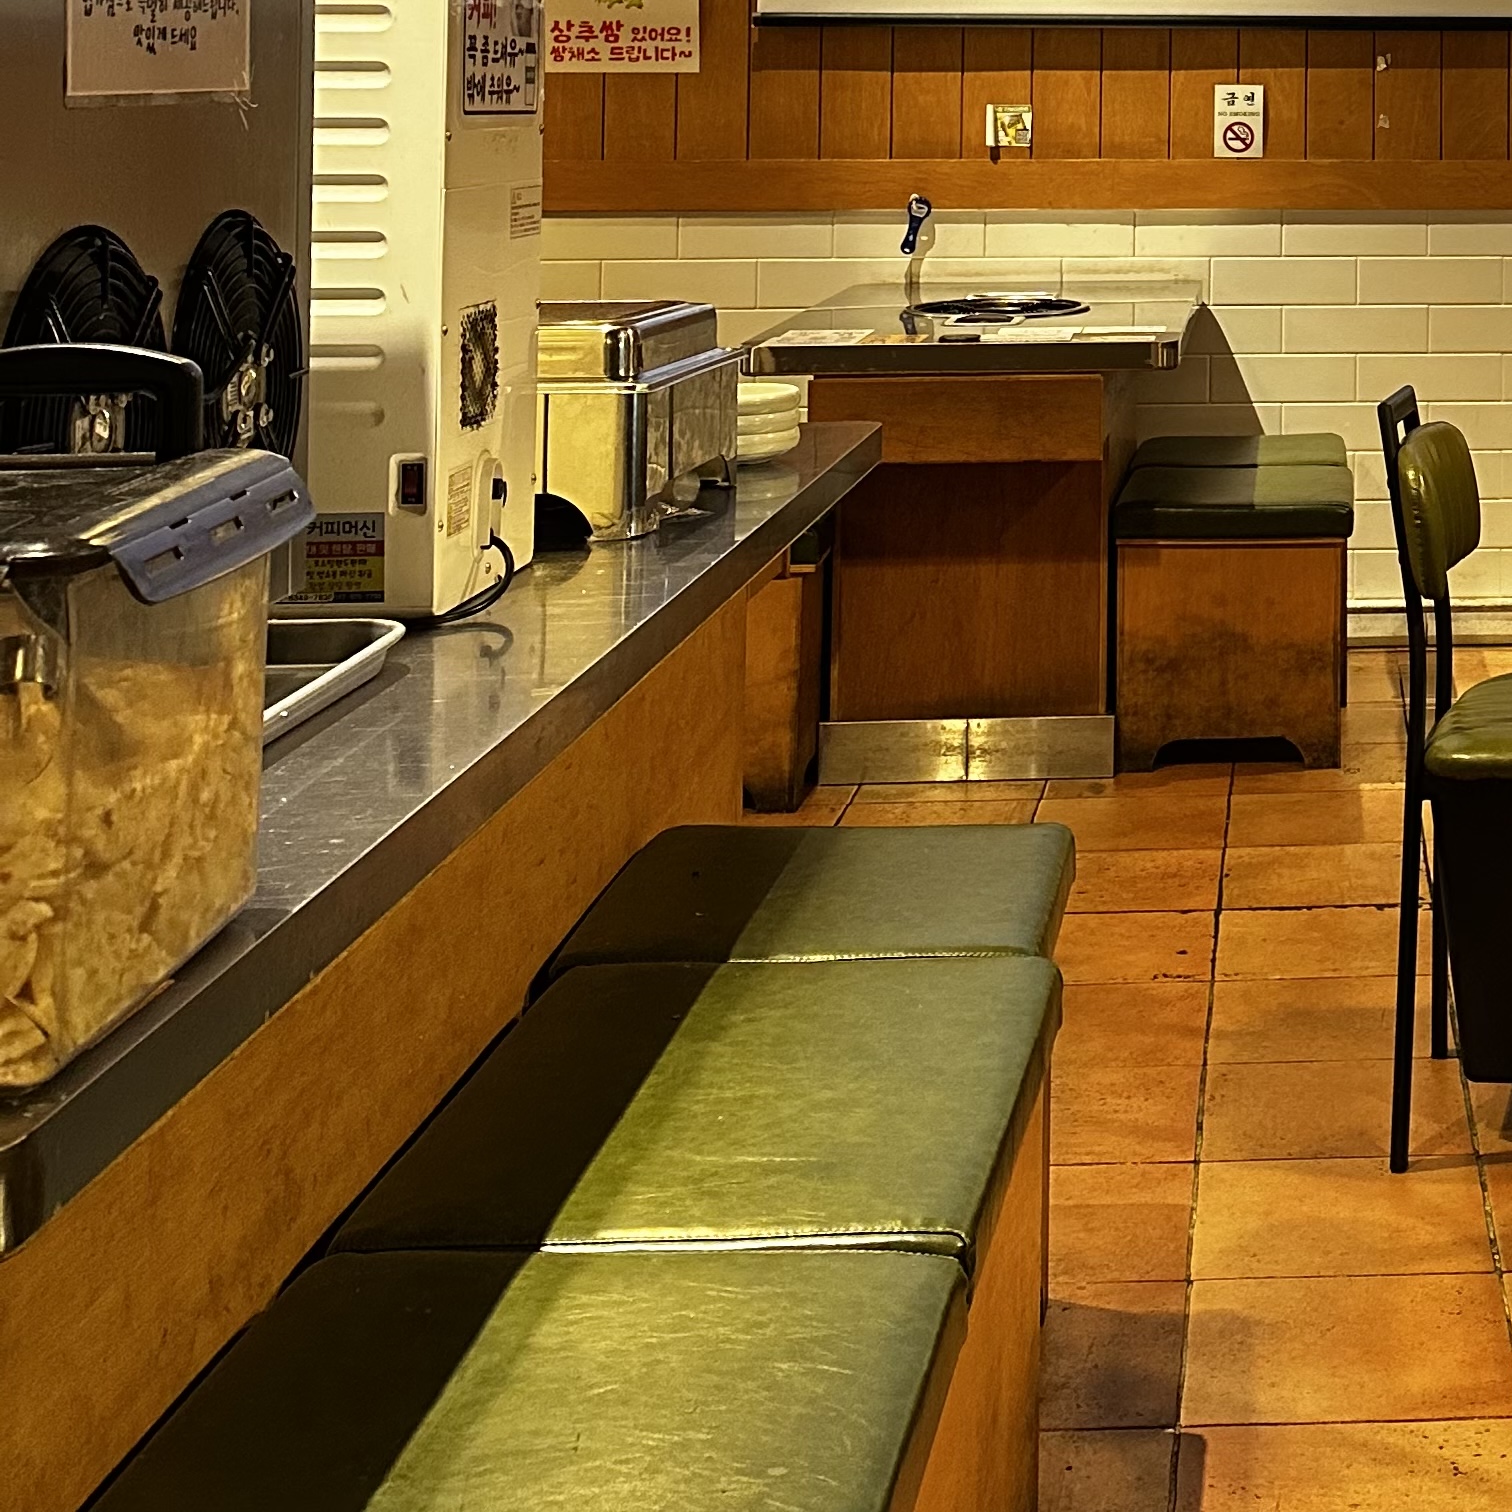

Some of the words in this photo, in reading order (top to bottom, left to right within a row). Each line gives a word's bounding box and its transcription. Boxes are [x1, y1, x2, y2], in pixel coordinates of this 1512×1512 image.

[133, 24, 166, 55] 맛있게
[170, 25, 197, 51] 드세요
[550, 20, 625, 43] 상추쌈
[631, 26, 692, 43] 있어요!
[480, 34, 490, 67] 좀
[550, 46, 602, 63] 쌈채소
[608, 45, 693, 63] 드립니다~
[466, 72, 487, 105] 밖에
[306, 519, 377, 539] 커피머신
